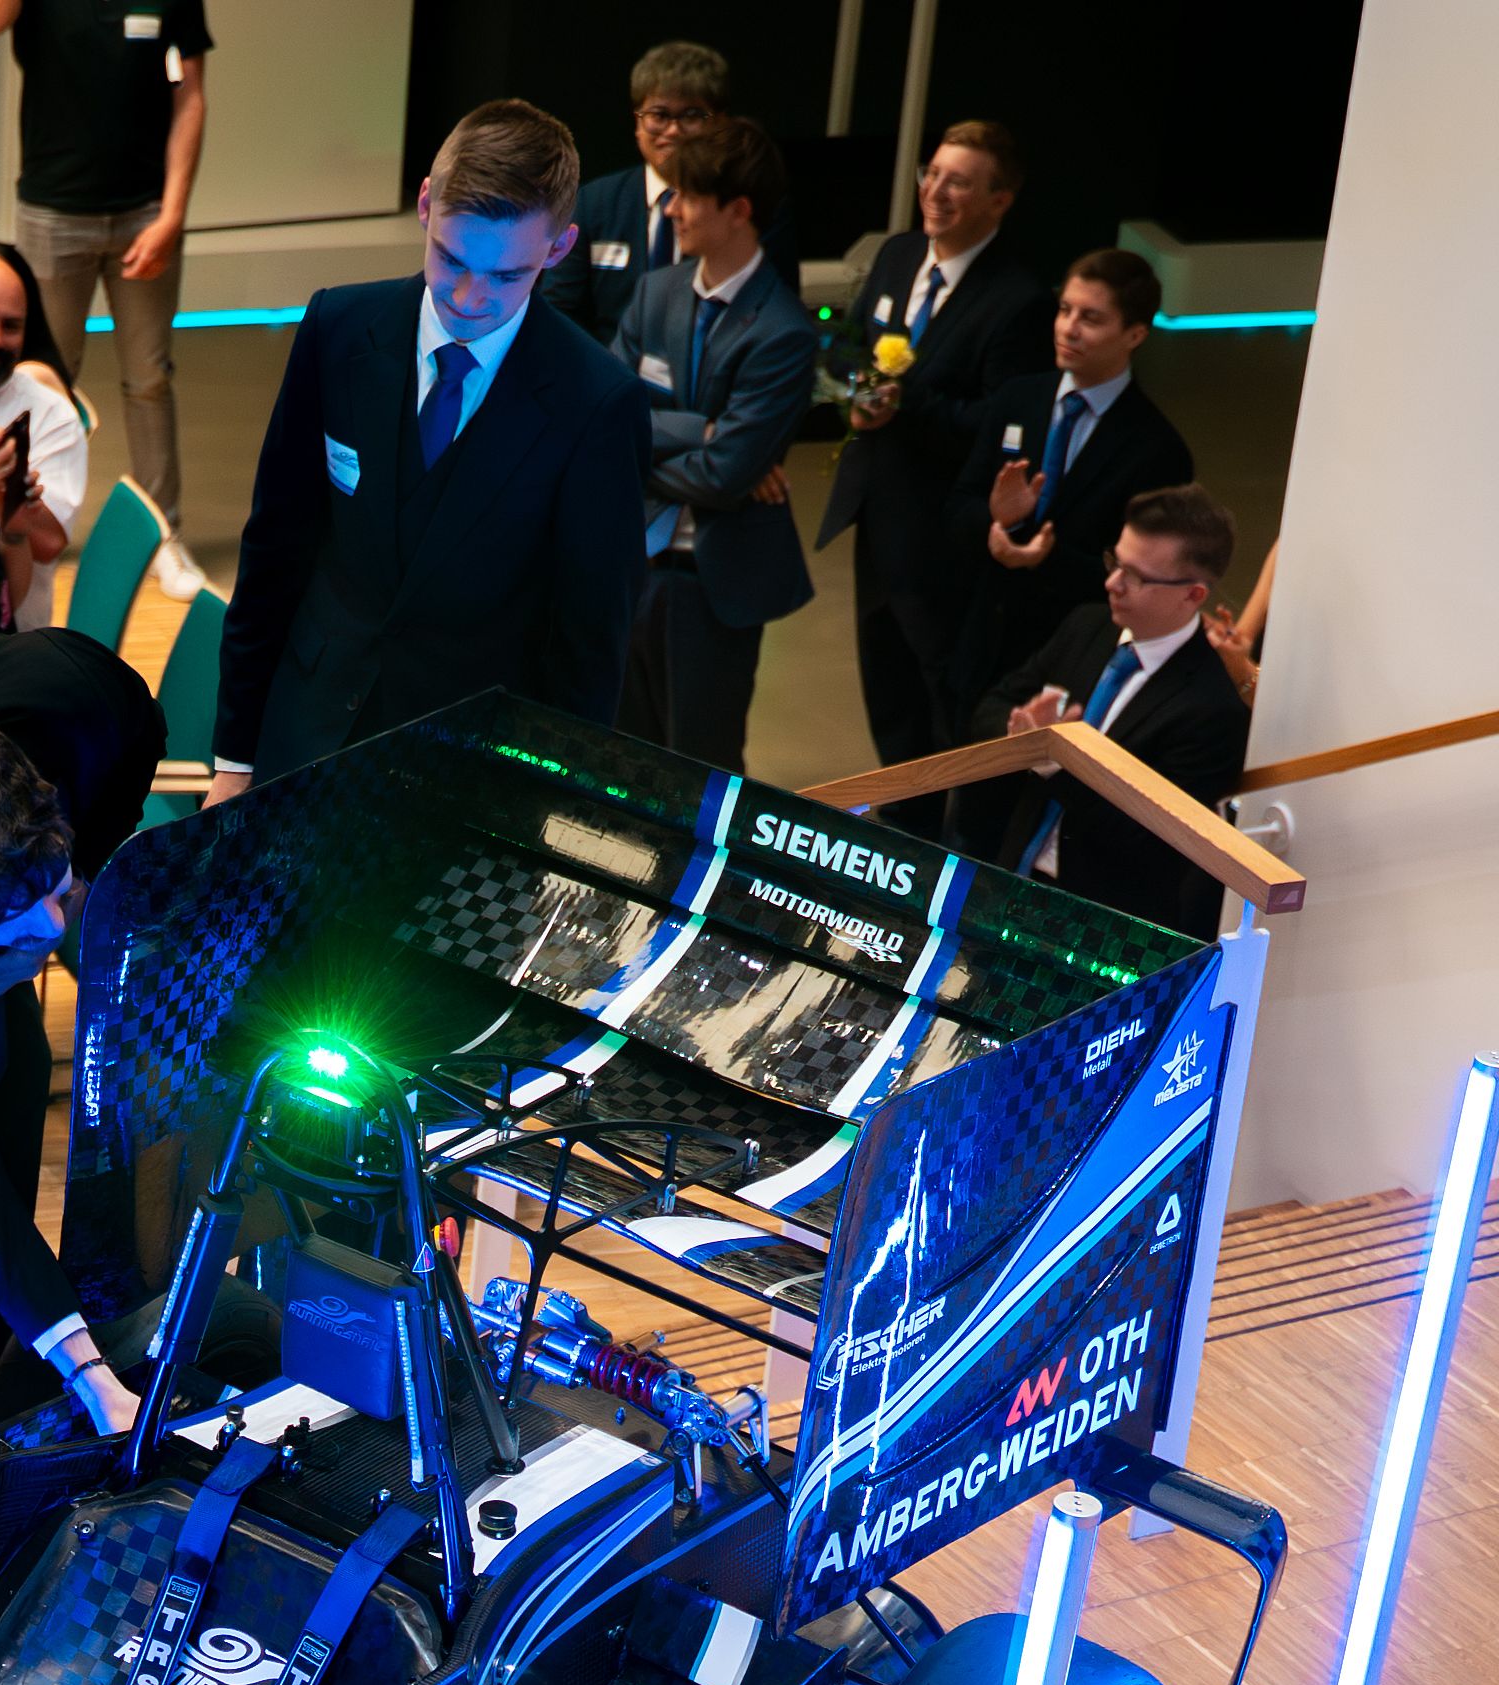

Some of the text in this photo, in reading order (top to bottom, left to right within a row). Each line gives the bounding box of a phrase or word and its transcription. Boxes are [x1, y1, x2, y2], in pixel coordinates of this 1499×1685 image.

[751, 813, 917, 896] SIEMENS
[749, 878, 904, 952] MOTORWORLD
[1083, 1052, 1112, 1080] Metall
[1085, 1018, 1145, 1063] DIEHL
[836, 1296, 946, 1371] FISCHER
[851, 1332, 925, 1377] Elektromotoren
[1079, 1309, 1153, 1384] OTH
[811, 1367, 1144, 1584] AMBERG-WEIDEN
[171, 1581, 197, 1597] TRS
[302, 1641, 326, 1660] TRS
